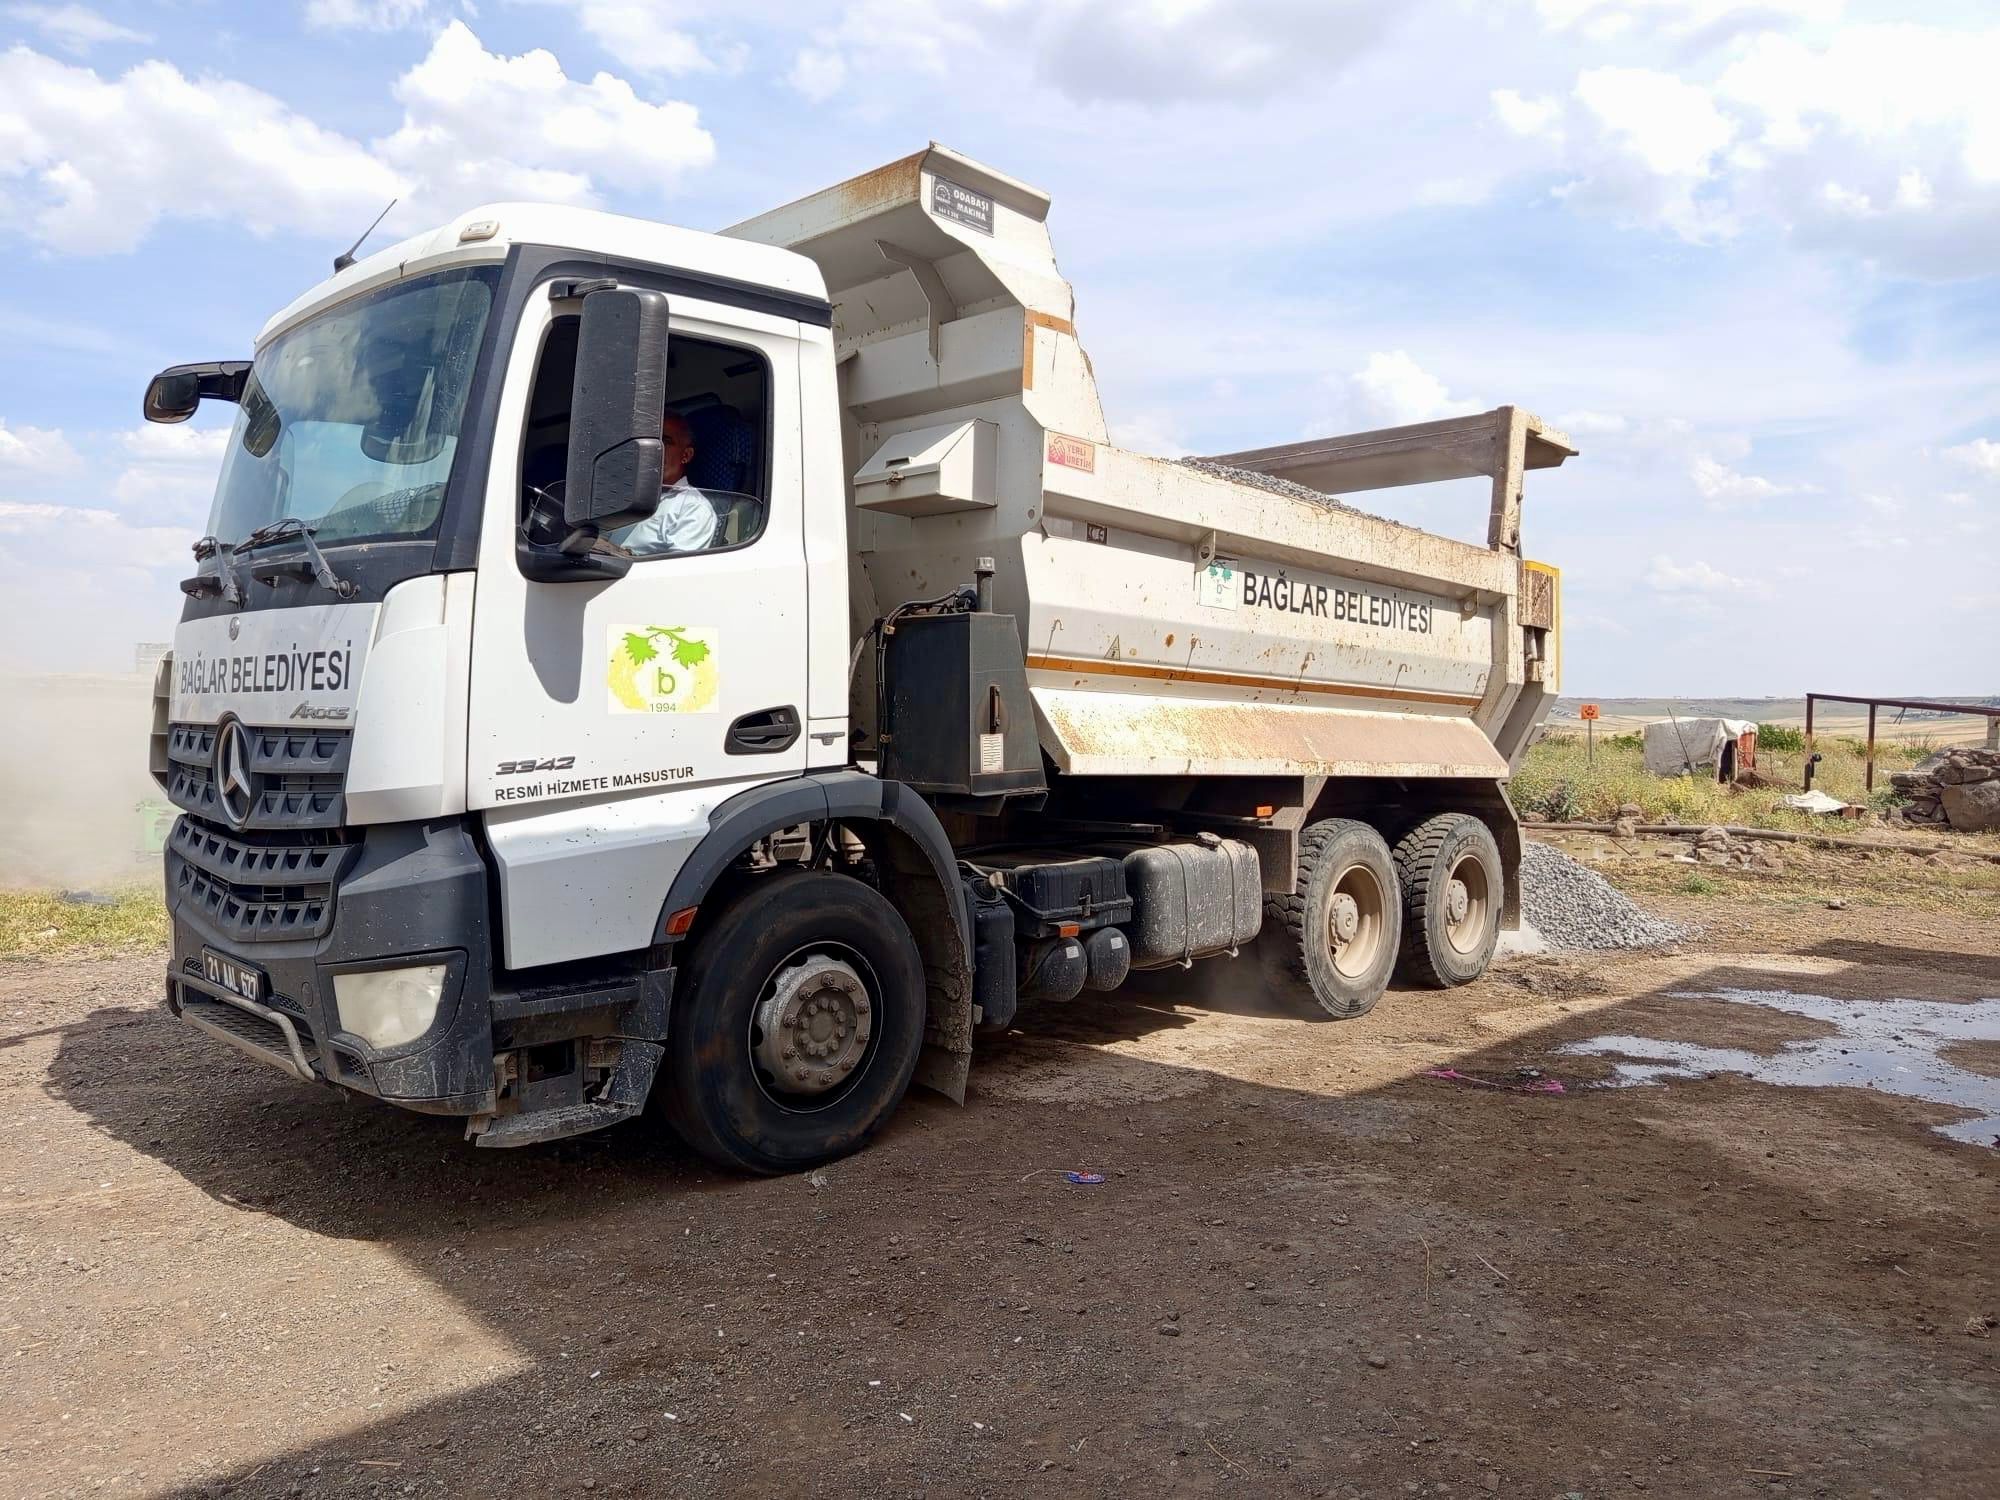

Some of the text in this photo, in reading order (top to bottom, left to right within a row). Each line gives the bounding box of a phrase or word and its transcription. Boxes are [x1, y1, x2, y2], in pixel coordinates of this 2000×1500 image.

[1243, 569, 1433, 634] BAĞLAR BELEDİYESİ
[180, 640, 351, 694] BAĞLAR BELEDİYESİ
[650, 702, 676, 712] 1994
[495, 756, 576, 776] 3342
[495, 766, 694, 801] RESMİ HİZMETE MAHSUSTUR
[208, 956, 220, 983] 21
